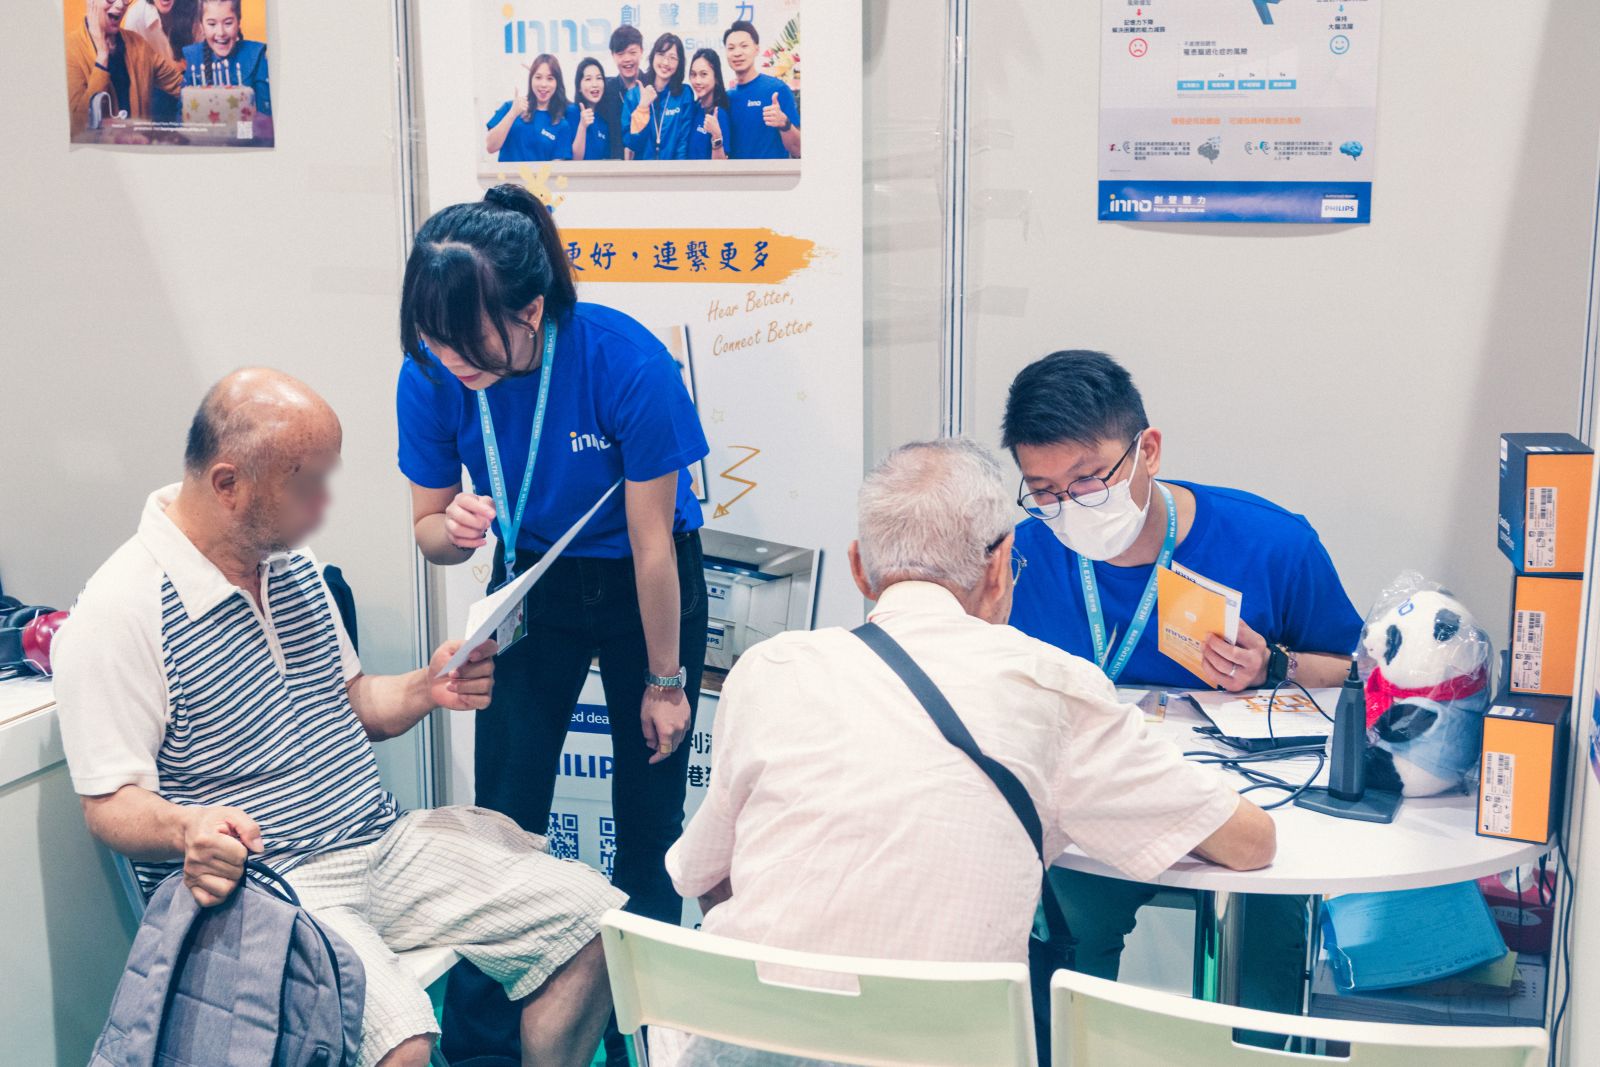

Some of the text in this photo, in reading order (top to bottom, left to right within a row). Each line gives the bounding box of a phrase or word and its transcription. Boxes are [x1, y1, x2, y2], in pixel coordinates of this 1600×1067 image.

[501, 2, 610, 54] inno
[1109, 193, 1152, 213] inno
[1324, 204, 1355, 212] PHILIPS
[707, 289, 795, 323] Hear Better,
[712, 320, 814, 357] Connect Better
[533, 410, 544, 440] HEALTH
[487, 445, 500, 478] HEALTH
[493, 477, 504, 498] EXPO
[515, 491, 528, 521] HEALTH
[1168, 505, 1178, 538] HEALTH
[1083, 569, 1093, 591] EXPO
[1138, 594, 1154, 621] HEALTH
[1093, 623, 1104, 651] HEALTH
[1117, 645, 1131, 663] EXPO
